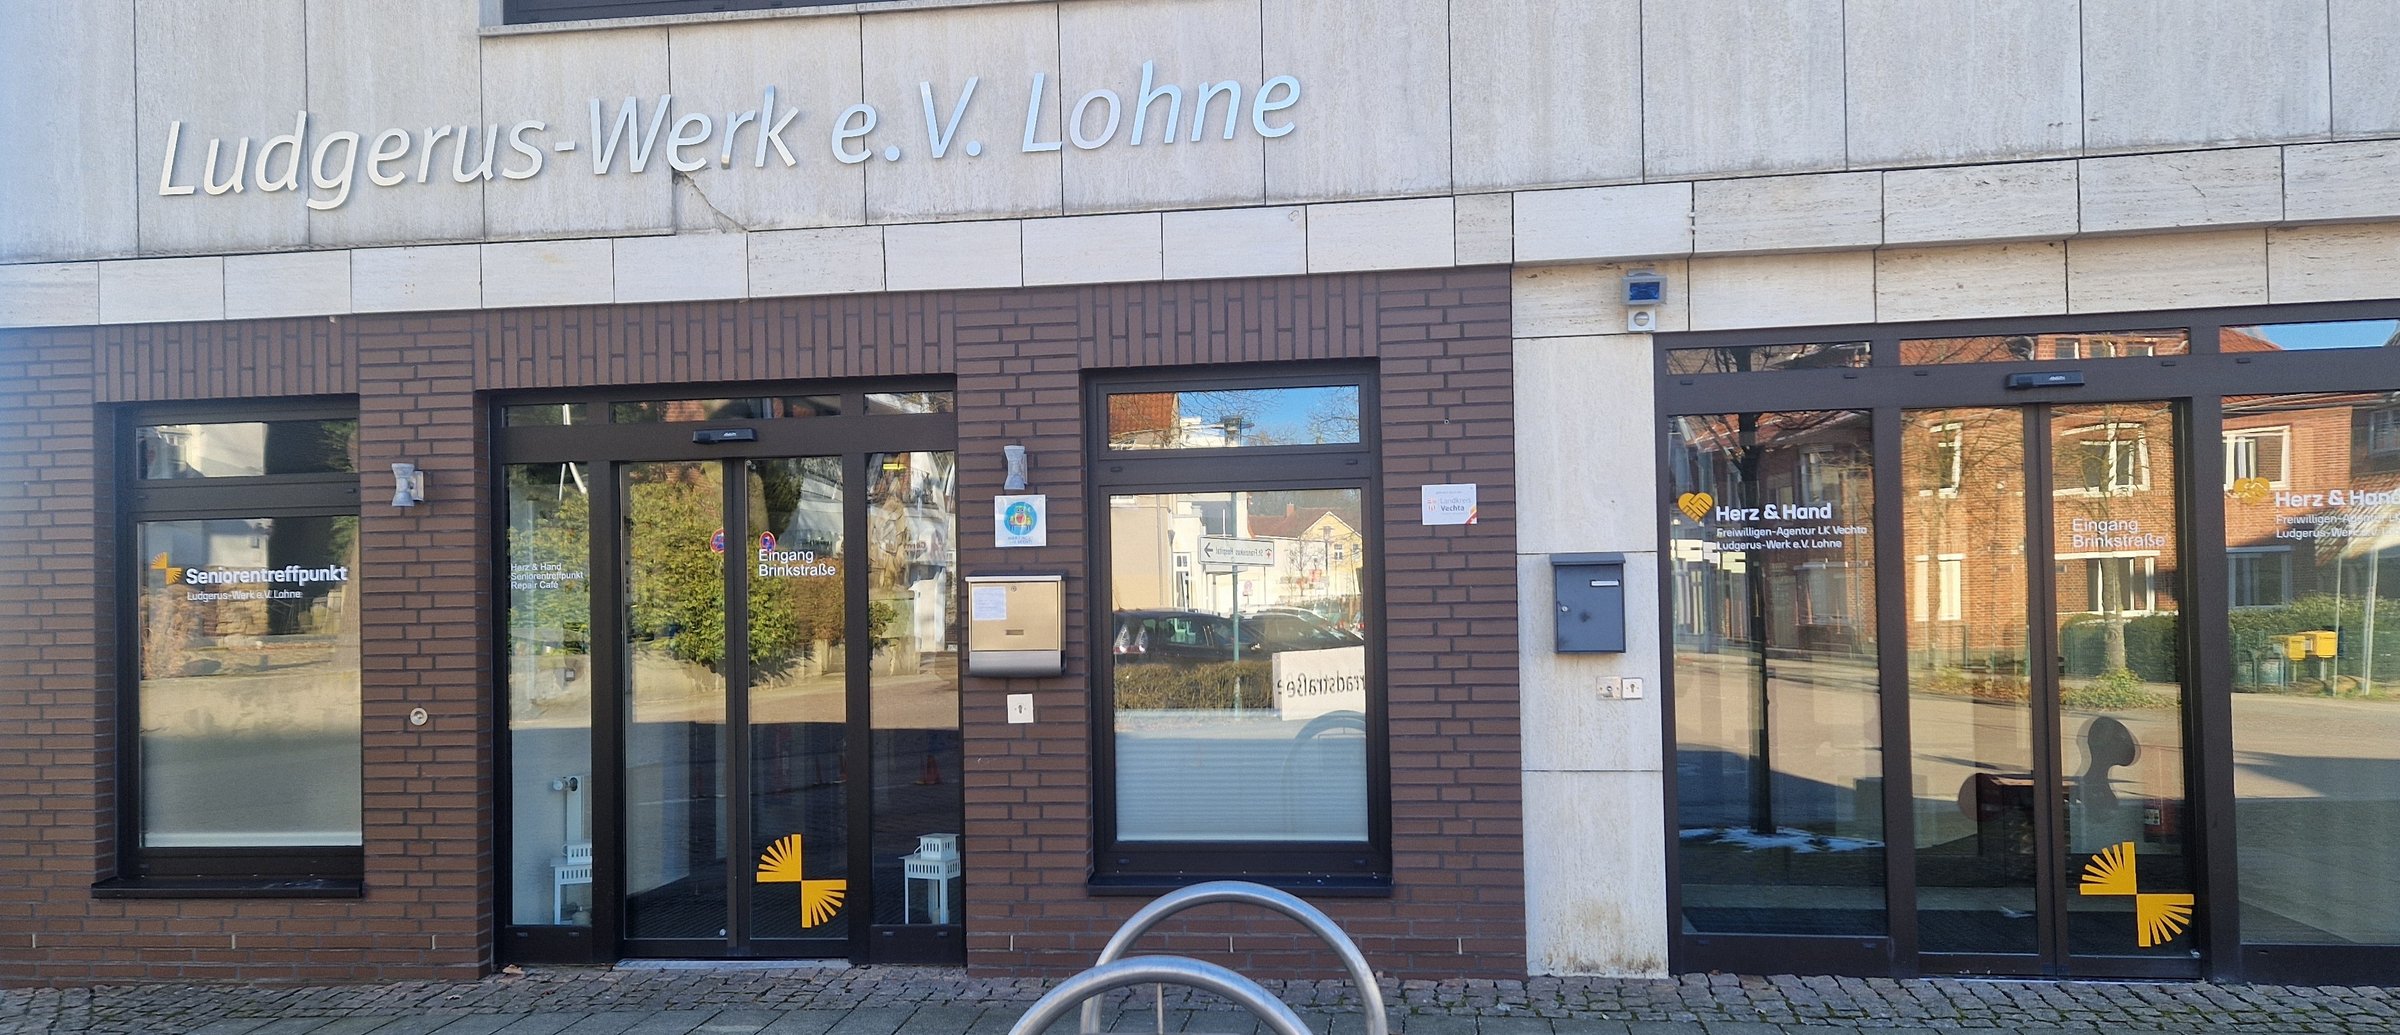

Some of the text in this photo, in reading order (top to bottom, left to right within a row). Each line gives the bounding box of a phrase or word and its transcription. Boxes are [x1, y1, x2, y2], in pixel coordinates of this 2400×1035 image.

[158, 59, 1301, 210] Ludgerus-Werk e.V. Lohne
[2275, 491, 2324, 508] Herz
[2327, 489, 2346, 506] &
[1715, 502, 1832, 521] Herz & Hand
[1716, 525, 1868, 538] Freiwilligen-Agentur LK Vechta
[2072, 518, 2138, 533] Eingang
[1716, 539, 1792, 551] Ludgerus-Werk
[1811, 538, 1842, 549] Lohne
[2073, 533, 2165, 548] Brinkstraße
[759, 549, 814, 564] Eingang
[511, 563, 530, 571] Herz
[540, 563, 562, 571] Hand
[759, 563, 836, 576] Brinkstraße
[186, 564, 349, 586] Seniorentreffpunkt
[511, 571, 584, 581] Seniorentreffpunkt
[539, 580, 559, 589] Café
[187, 590, 255, 602] Ludgerus-Werk
[274, 588, 302, 599] Lohne
